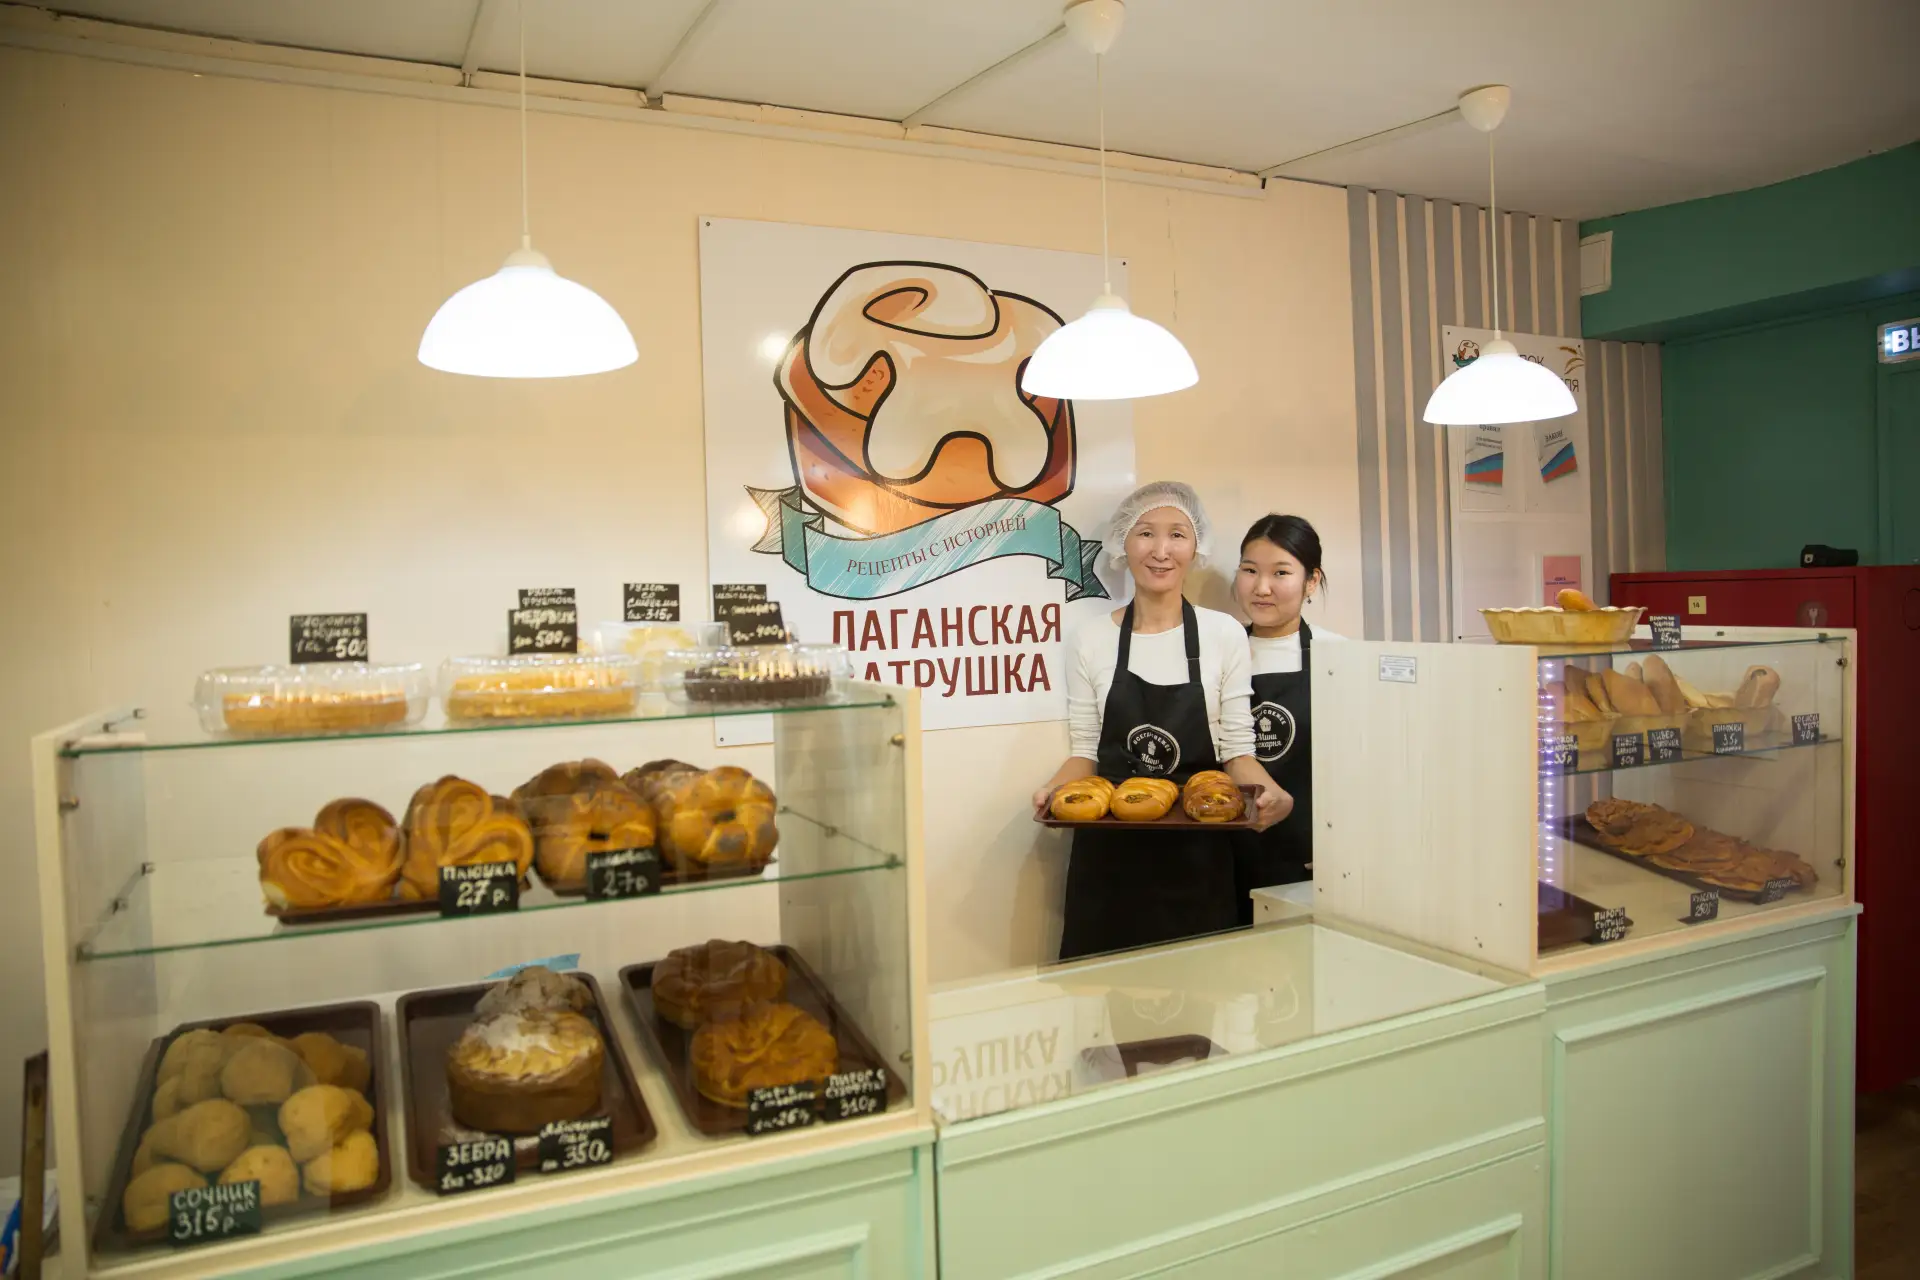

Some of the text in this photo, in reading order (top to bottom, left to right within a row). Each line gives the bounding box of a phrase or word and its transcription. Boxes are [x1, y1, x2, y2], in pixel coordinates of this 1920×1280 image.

[847, 513, 1027, 576] РЕЦЕПТЫ С ИСТОРИЕЙ
[832, 603, 1061, 651] ПАГАНСКАЯ
[863, 653, 1051, 698] АТРУШКА
[456, 879, 491, 908] 27
[446, 1138, 512, 1168] ЗЕБРА
[173, 1180, 256, 1212] СОЧНИК
